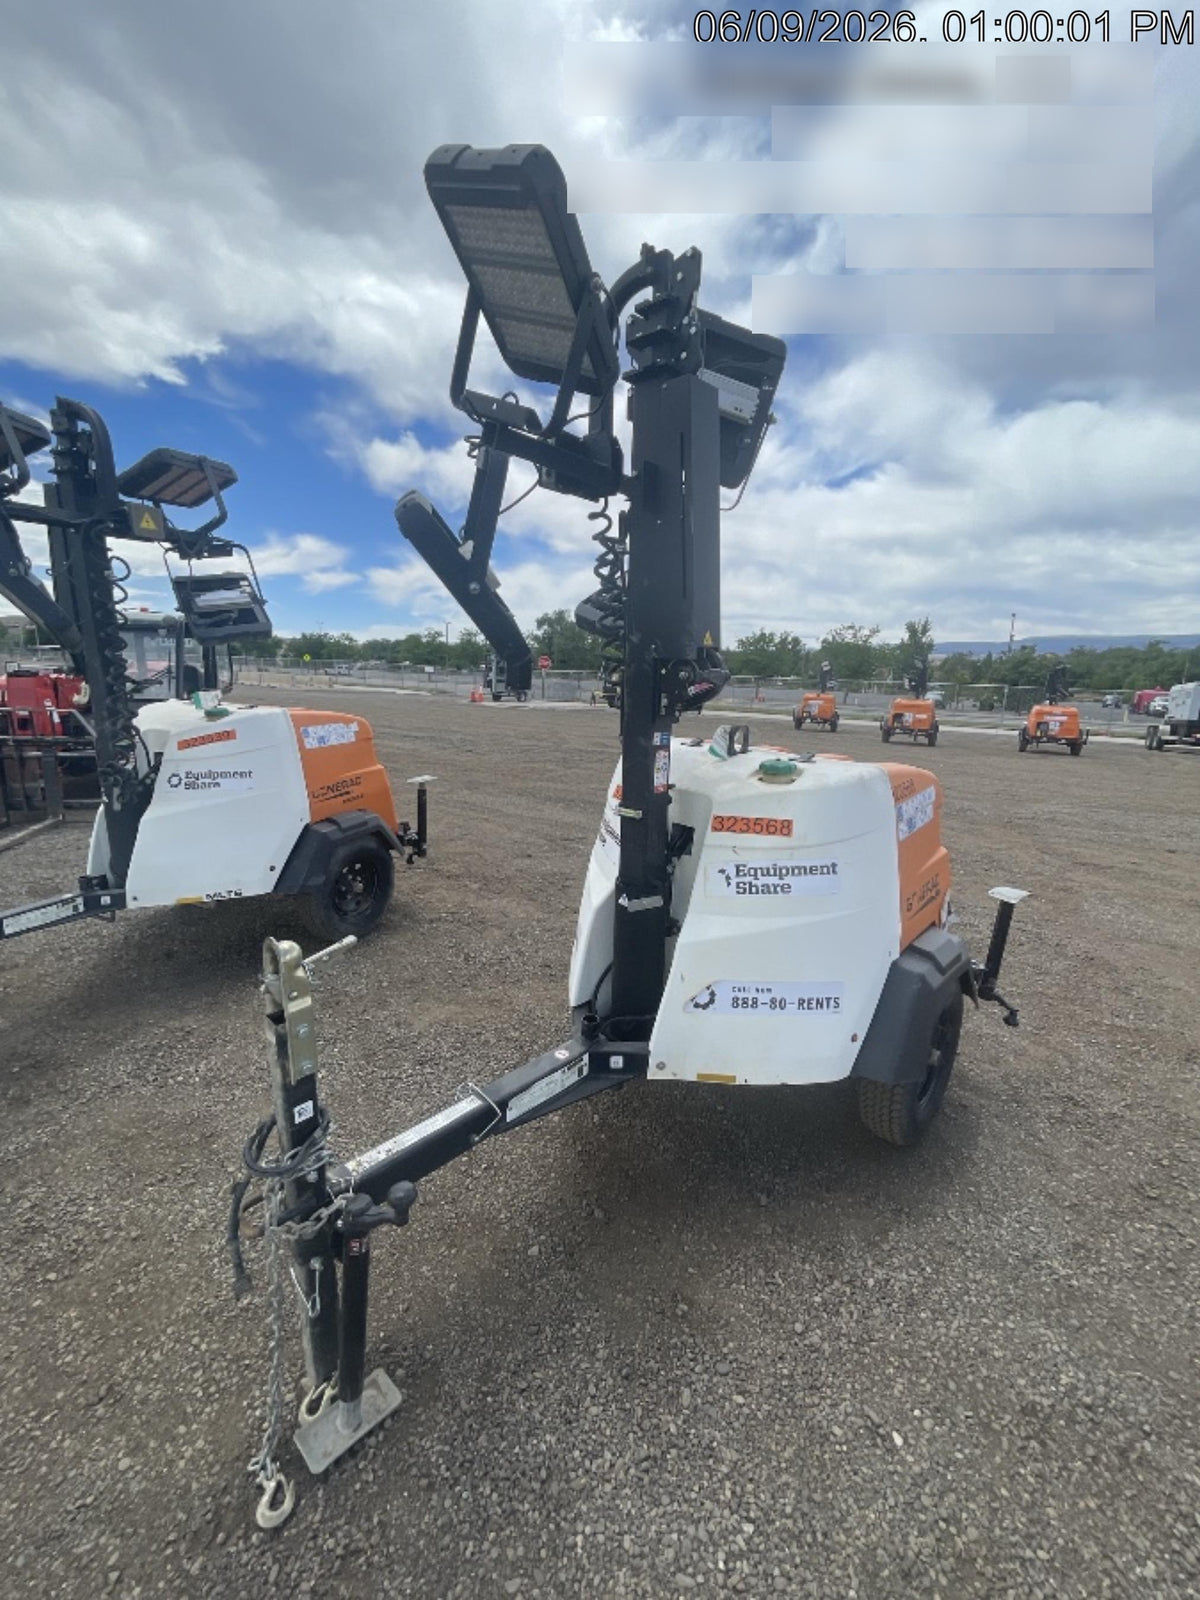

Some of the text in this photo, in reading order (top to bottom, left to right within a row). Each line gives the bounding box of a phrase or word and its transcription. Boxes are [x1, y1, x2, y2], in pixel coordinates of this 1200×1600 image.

[184, 769, 254, 781] Equipment
[184, 780, 221, 790] Share
[713, 815, 793, 836] 323568
[734, 862, 838, 880] Equipment
[735, 881, 792, 895] Share
[731, 996, 841, 1011] 888-80-RENTS
